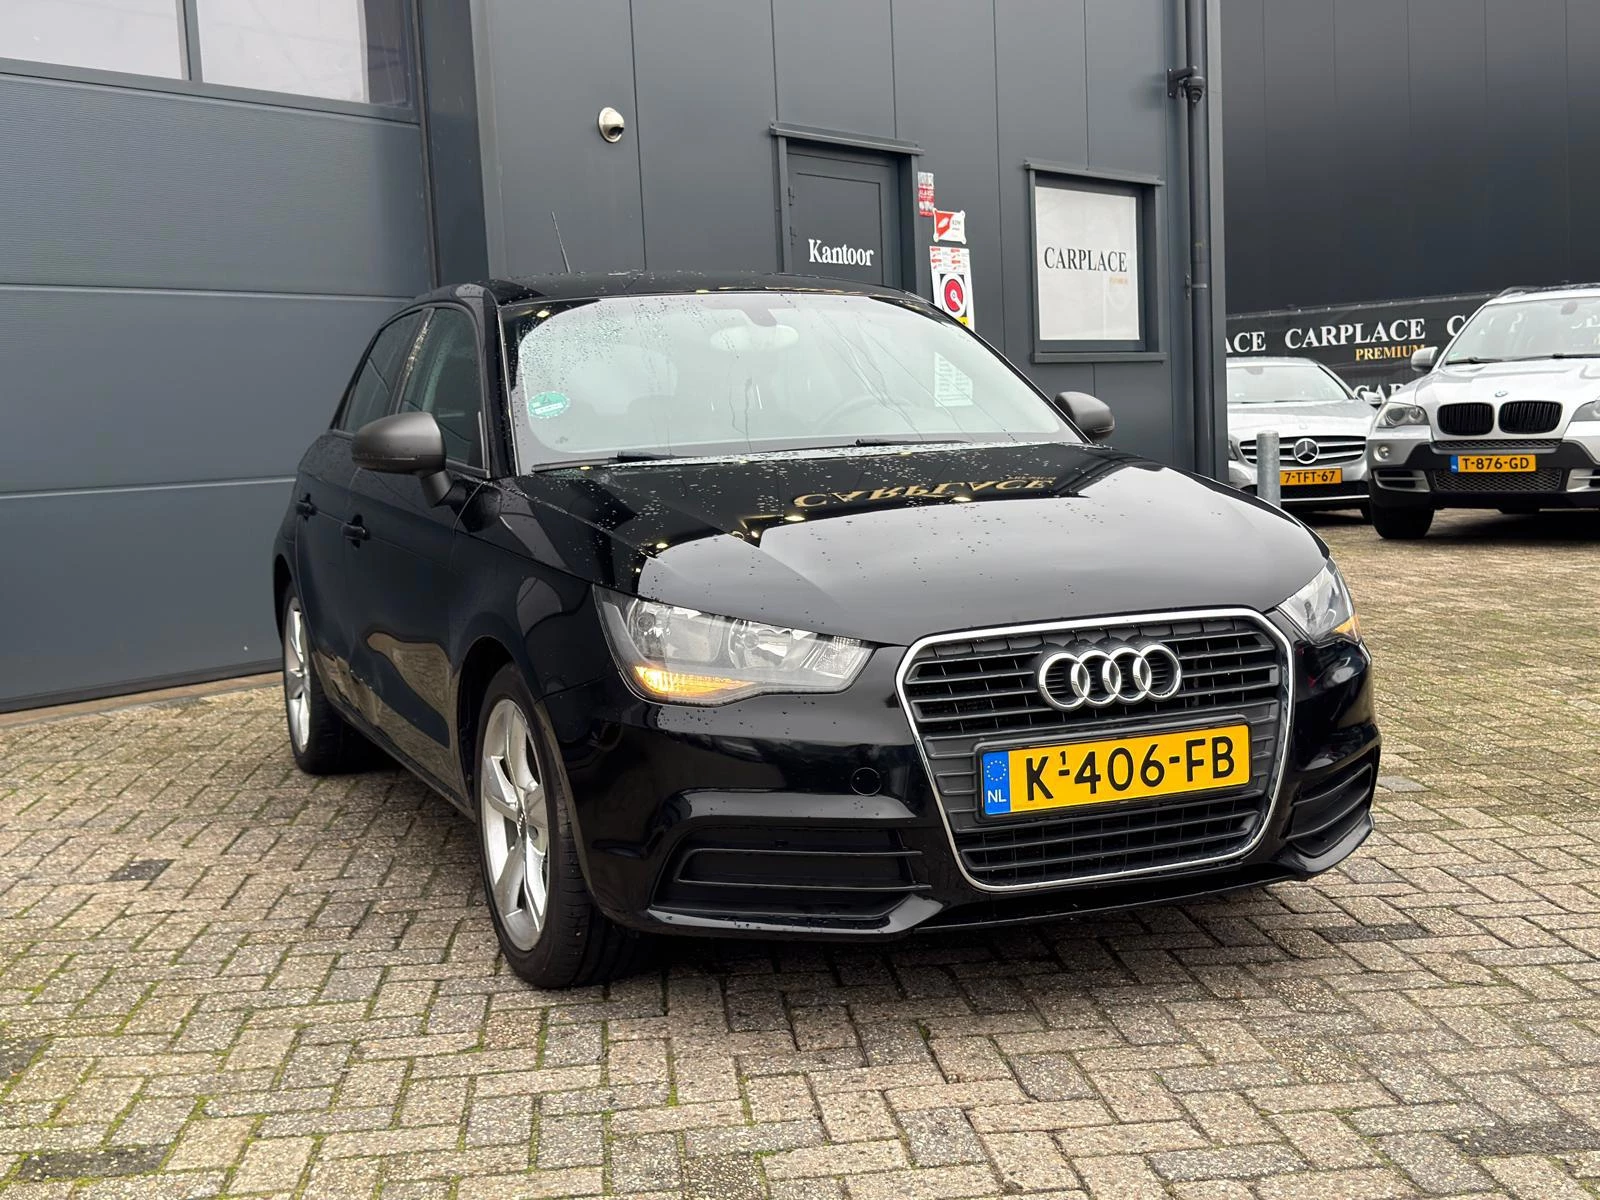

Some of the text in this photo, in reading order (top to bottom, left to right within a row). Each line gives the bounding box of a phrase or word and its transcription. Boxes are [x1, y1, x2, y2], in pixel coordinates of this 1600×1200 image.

[808, 238, 874, 266] Kantoor
[1044, 246, 1127, 272] CARPLACE
[1284, 318, 1426, 349] CARPLACE
[1461, 457, 1529, 470] T-876-GD
[1285, 470, 1336, 483] 7-TFT-67
[988, 790, 1007, 803] NL
